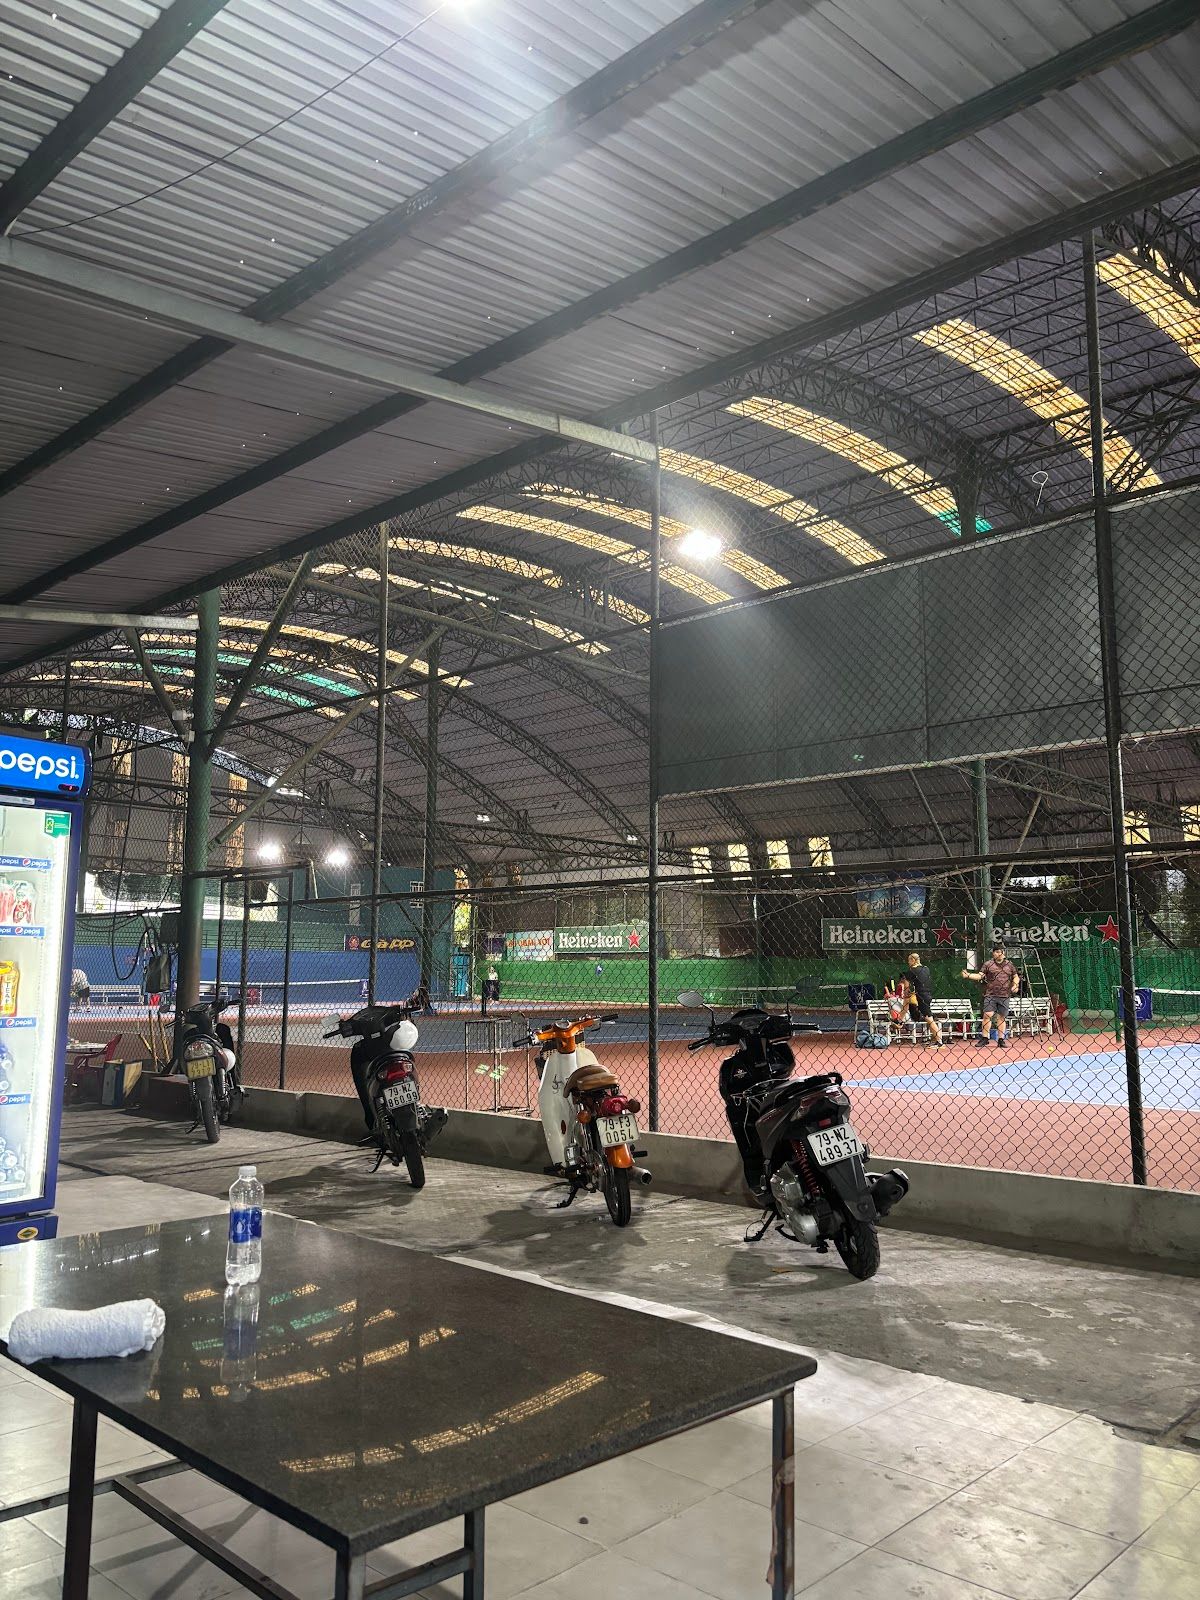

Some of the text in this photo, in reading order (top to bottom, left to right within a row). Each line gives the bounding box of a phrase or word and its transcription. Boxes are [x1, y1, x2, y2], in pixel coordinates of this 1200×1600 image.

[558, 931, 623, 949] Heineken
[829, 925, 927, 945] Heineken
[603, 1115, 631, 1131] 79-F3
[606, 1129, 634, 1143] 0054
[819, 1138, 858, 1162] 489.37
